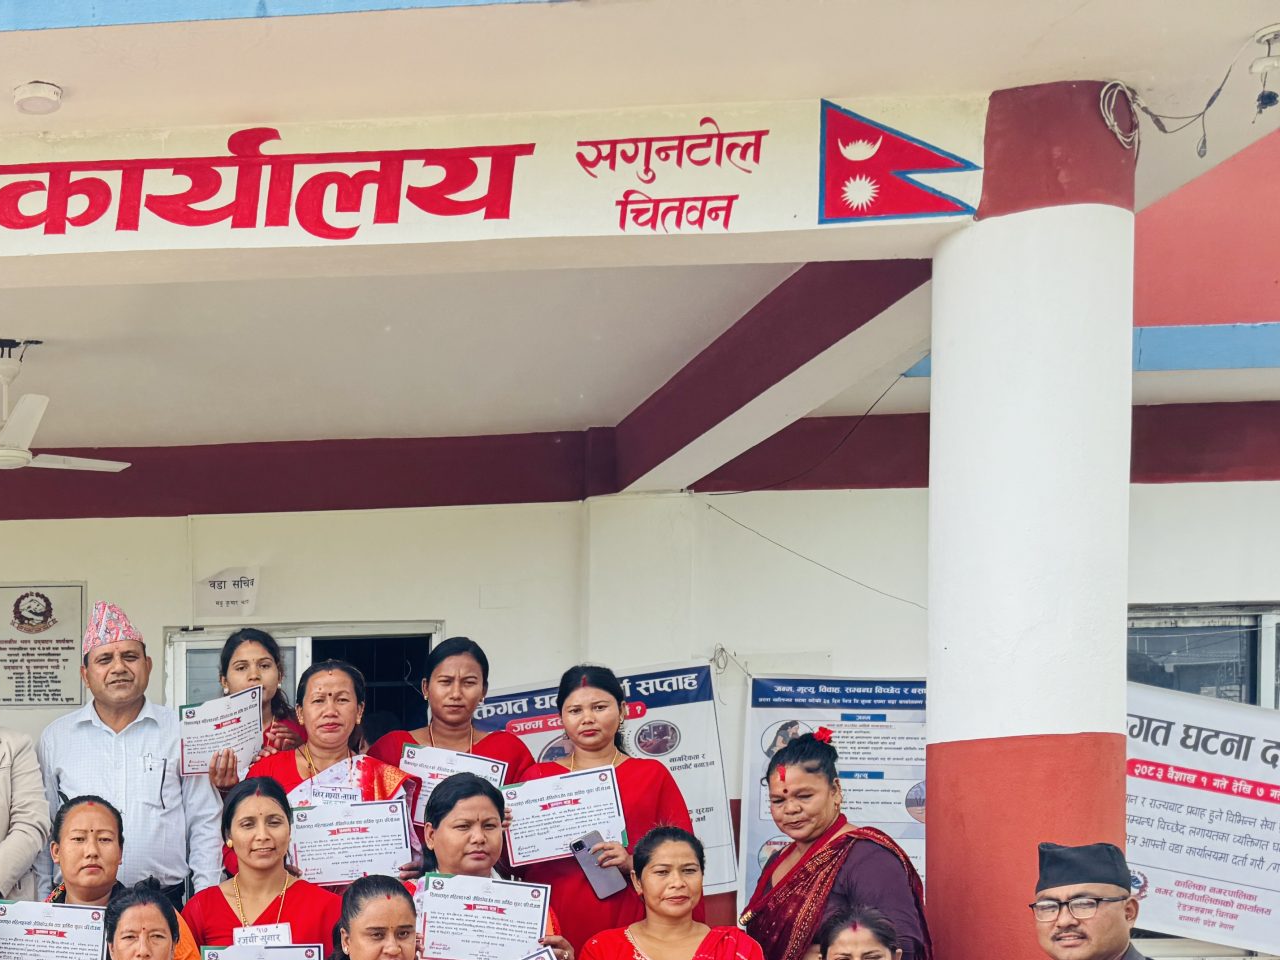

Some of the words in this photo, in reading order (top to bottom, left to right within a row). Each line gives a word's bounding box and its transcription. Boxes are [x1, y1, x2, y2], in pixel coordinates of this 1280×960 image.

[576, 117, 769, 184] सगुनटोल
[616, 189, 739, 234] चितवन
[635, 673, 698, 696] सप्ताह
[1180, 724, 1255, 762] घटना
[1226, 810, 1257, 827] विभिन्न
[1260, 817, 1276, 831] सेवा
[1168, 842, 1184, 854] वडा
